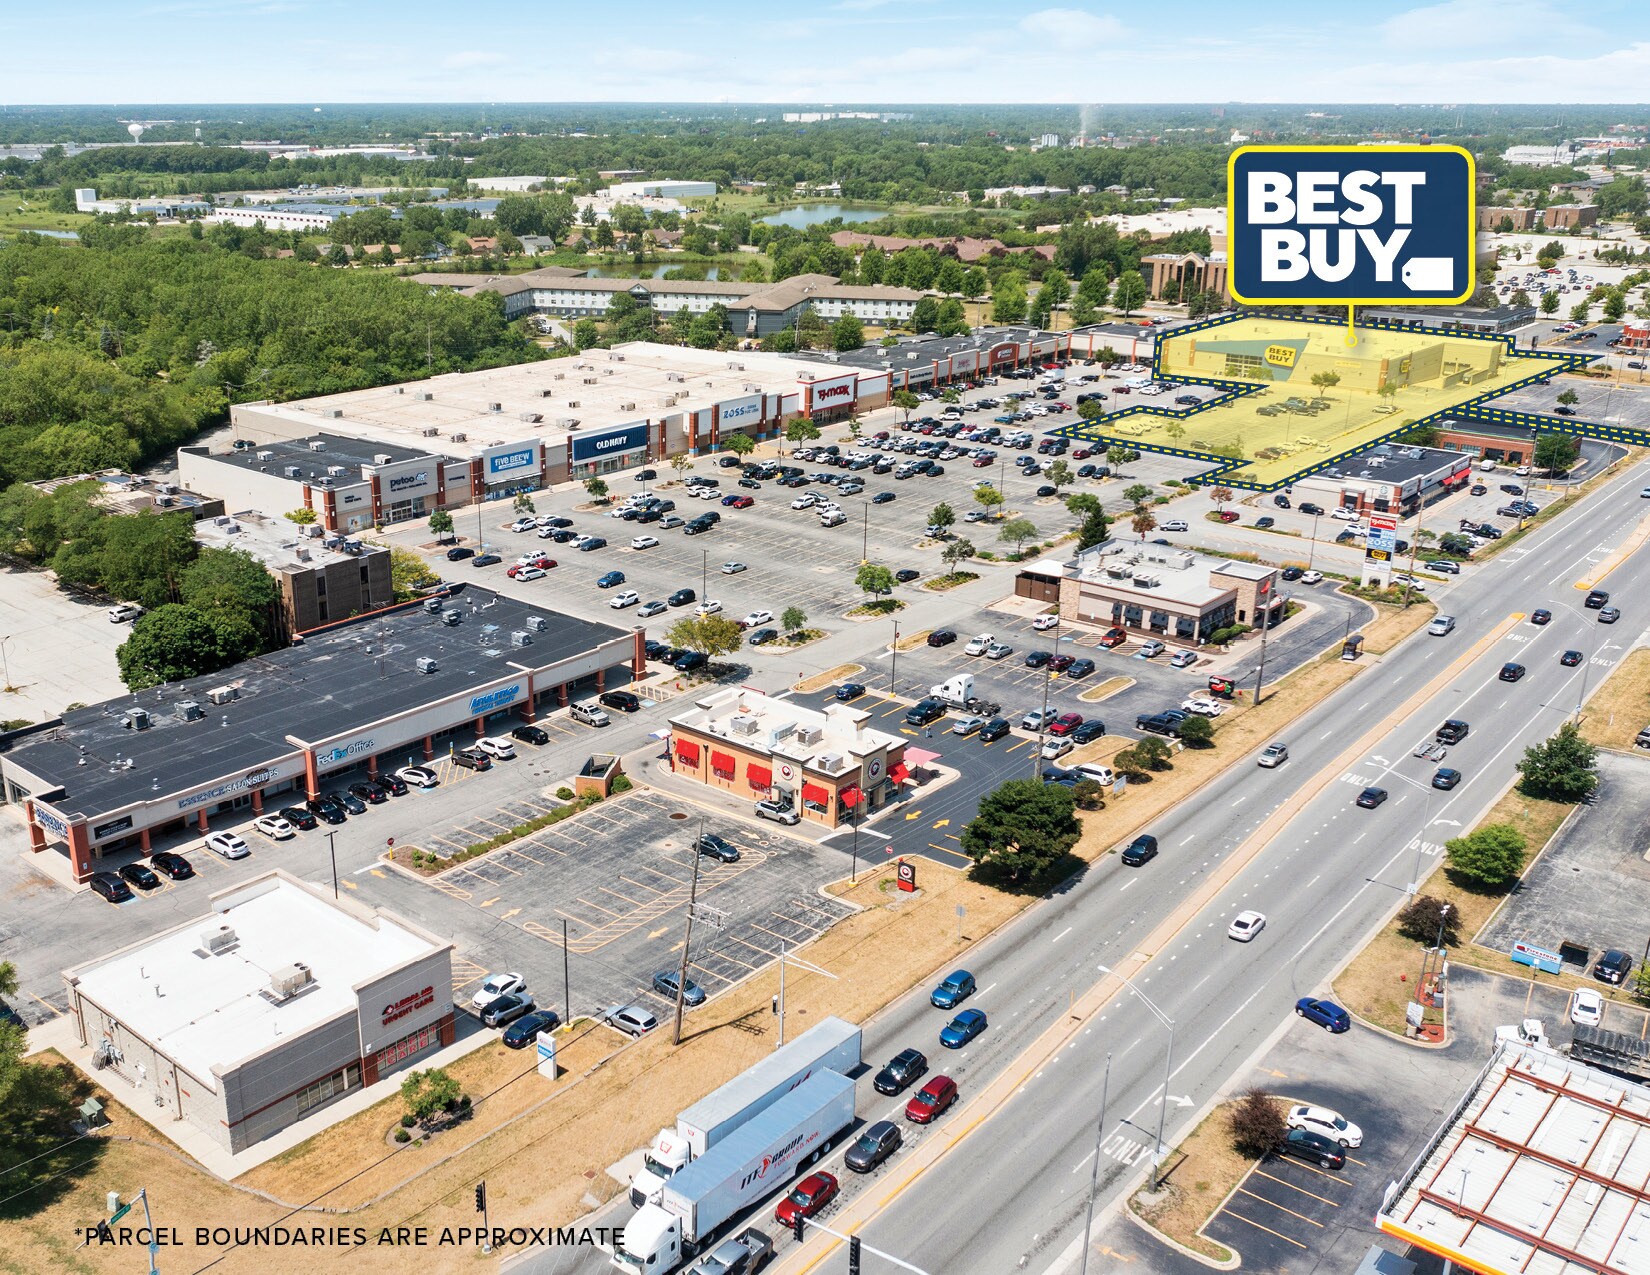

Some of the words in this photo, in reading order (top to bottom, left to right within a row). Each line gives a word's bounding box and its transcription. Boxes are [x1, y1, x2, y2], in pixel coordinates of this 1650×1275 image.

[1268, 345, 1295, 357] BEST
[1268, 353, 1290, 364] BUY
[723, 406, 745, 419] ROSS
[596, 440, 609, 449] OLD
[610, 436, 628, 447] NAVY
[390, 475, 415, 488] petco
[1507, 634, 1531, 643] ONLY
[1590, 658, 1616, 667] ONLY
[316, 748, 348, 767] FedEx
[346, 740, 376, 755] Office
[1340, 773, 1372, 786] ONLY
[1409, 840, 1446, 856] ONLY
[1526, 947, 1559, 961] Firestone
[382, 1006, 414, 1026] URGENT
[414, 995, 434, 1010] CARE
[387, 1038, 429, 1066] CARE
[774, 1143, 805, 1169] FORWARD
[1103, 1135, 1153, 1167] ONLY
[740, 1166, 762, 1190] ITF
[772, 1133, 804, 1165] GROUP
